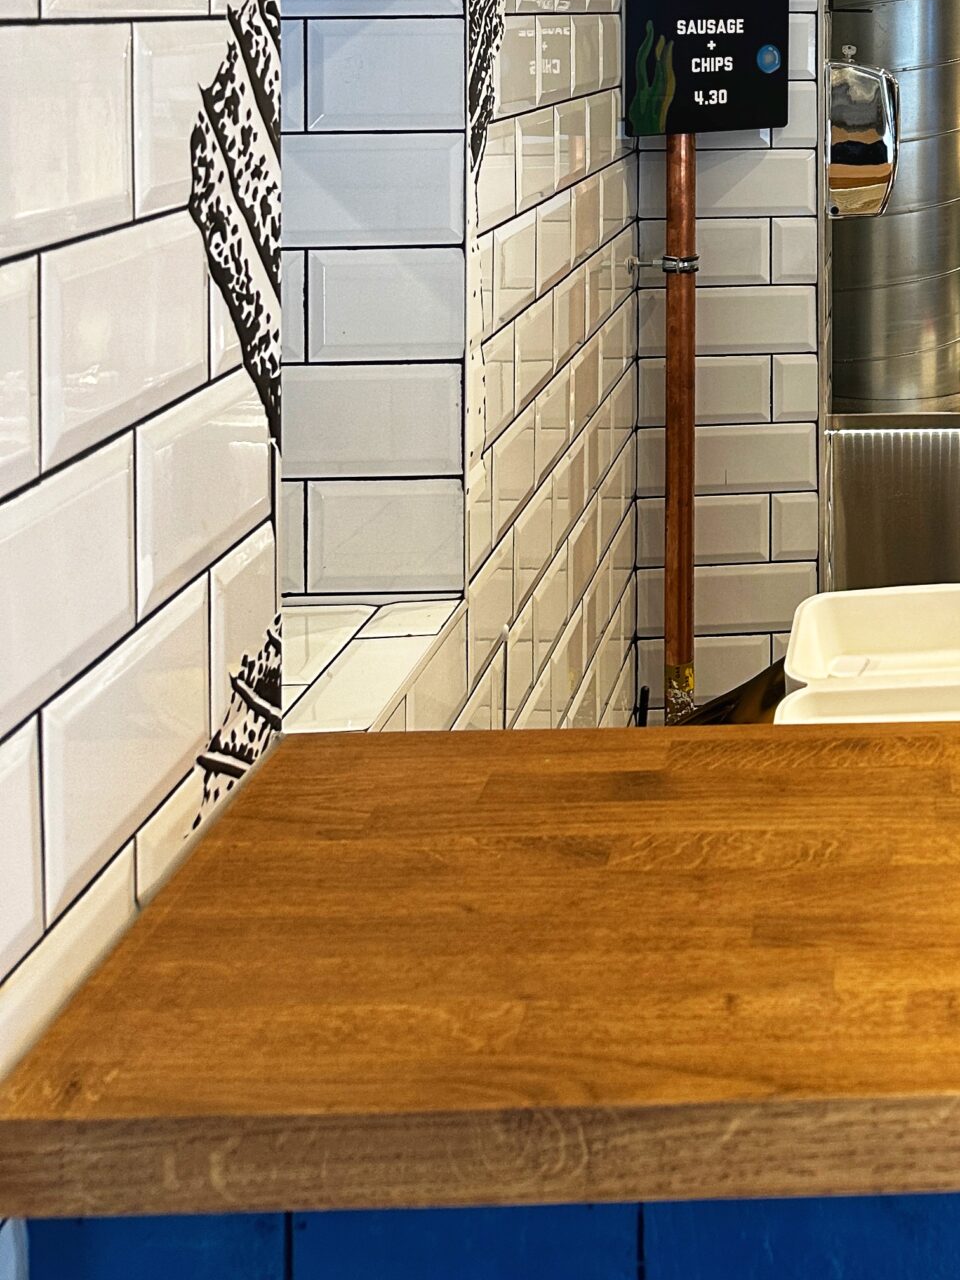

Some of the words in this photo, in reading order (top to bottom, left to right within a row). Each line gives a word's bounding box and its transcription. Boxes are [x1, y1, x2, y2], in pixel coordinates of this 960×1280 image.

[677, 19, 744, 34] SAUSAGE
[707, 41, 716, 50] +
[692, 57, 733, 72] CHIPS
[695, 89, 727, 105] 4.30
